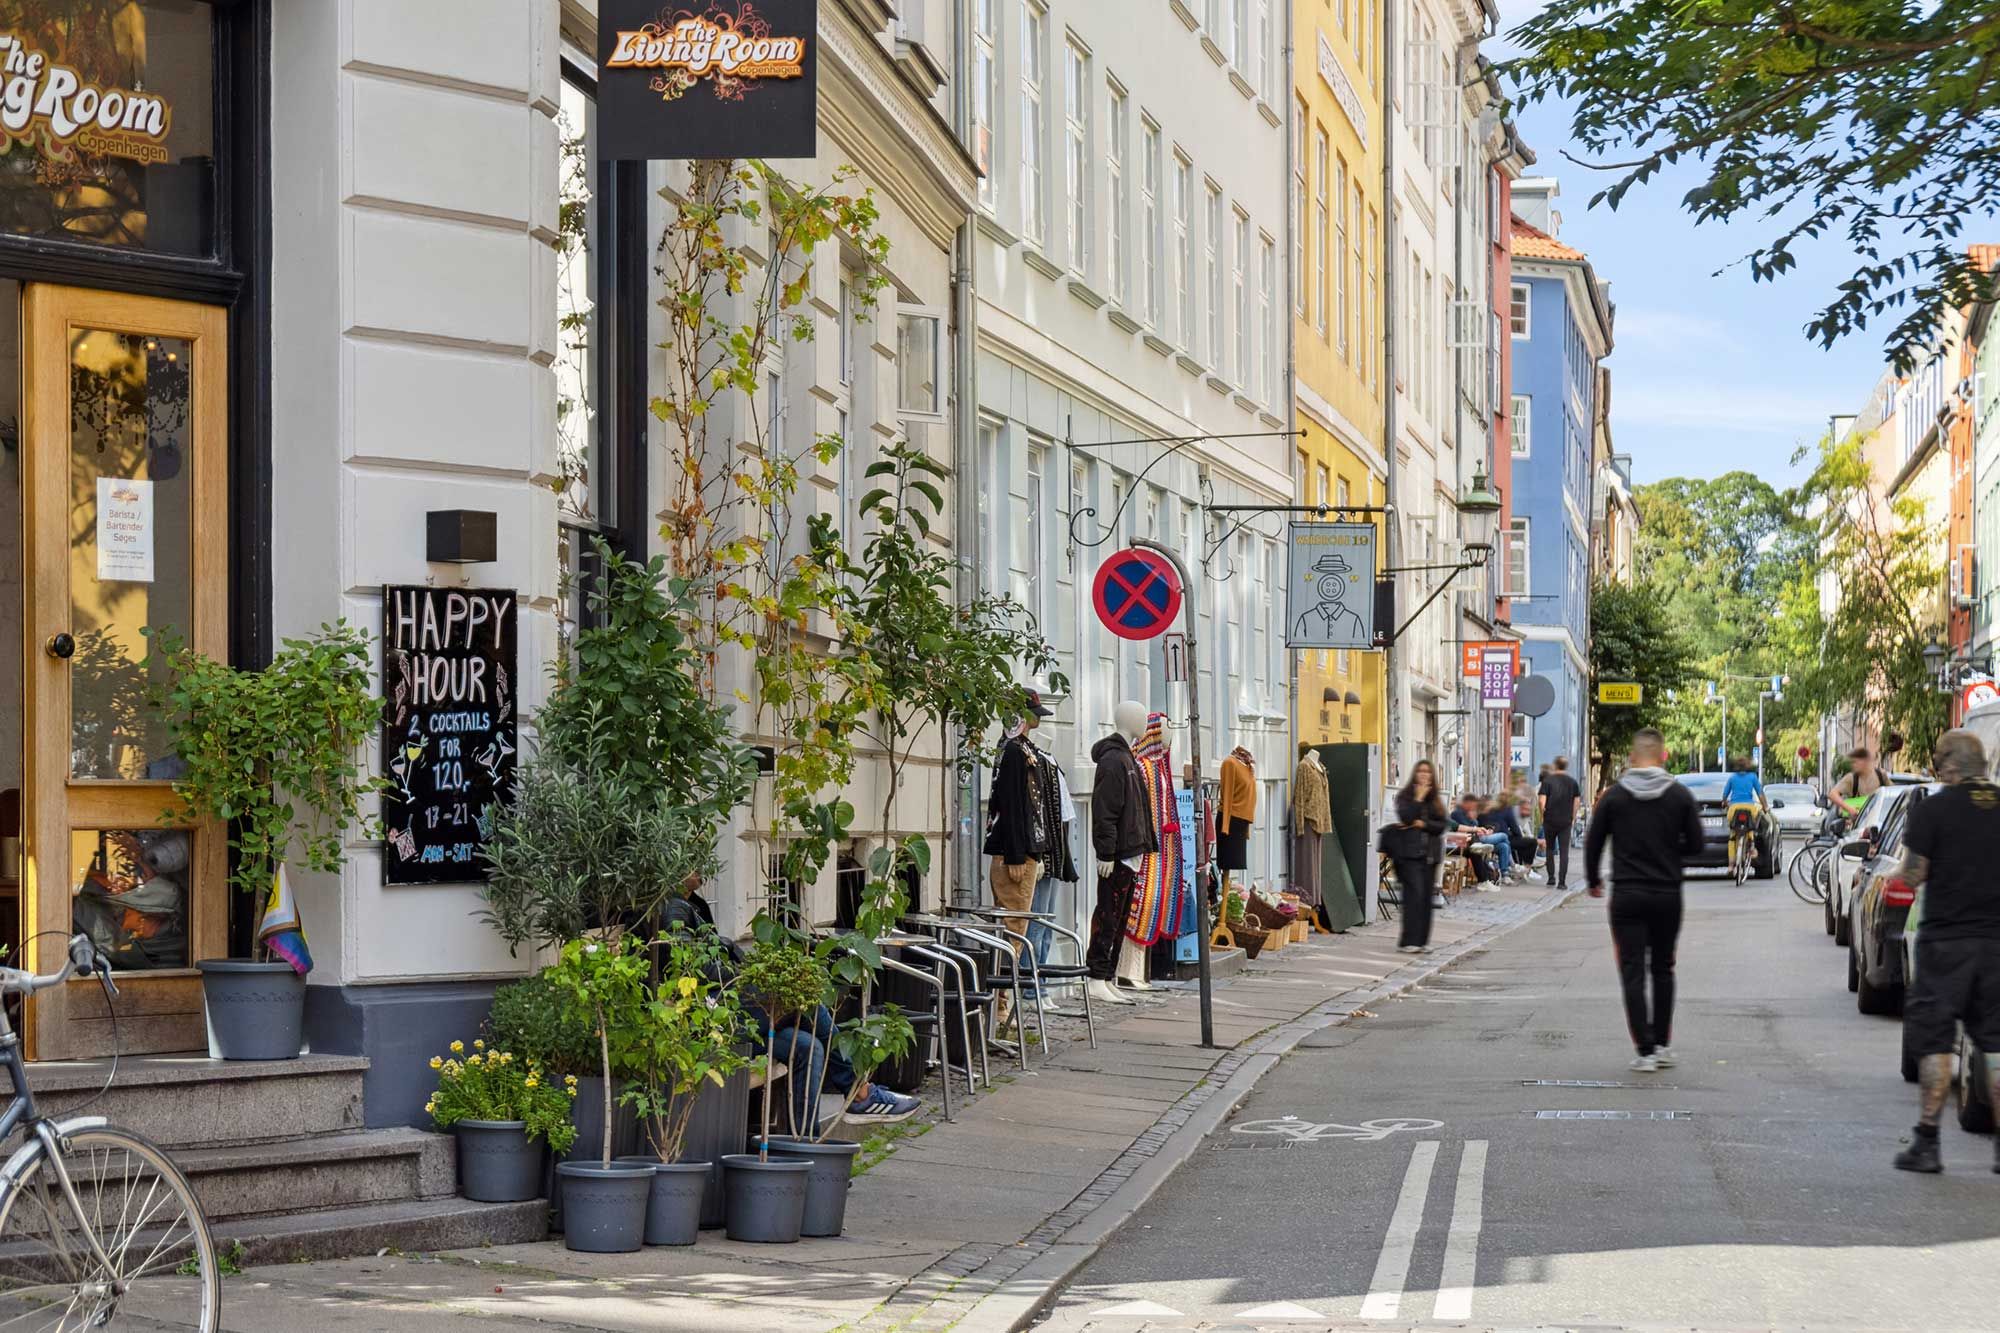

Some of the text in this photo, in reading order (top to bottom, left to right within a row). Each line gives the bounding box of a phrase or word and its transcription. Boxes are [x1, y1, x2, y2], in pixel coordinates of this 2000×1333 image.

[678, 23, 717, 43] The
[613, 33, 798, 71] Living Room
[739, 63, 799, 76] Copenhagen
[34, 68, 164, 137] Room
[77, 131, 167, 161] Copenhagen
[106, 521, 143, 531] Bartender
[109, 510, 135, 519] Barista
[394, 590, 511, 650] HAPPY
[411, 655, 486, 704] HOUR
[408, 711, 491, 736] 2 COCKTAILS
[439, 737, 461, 758] FOR
